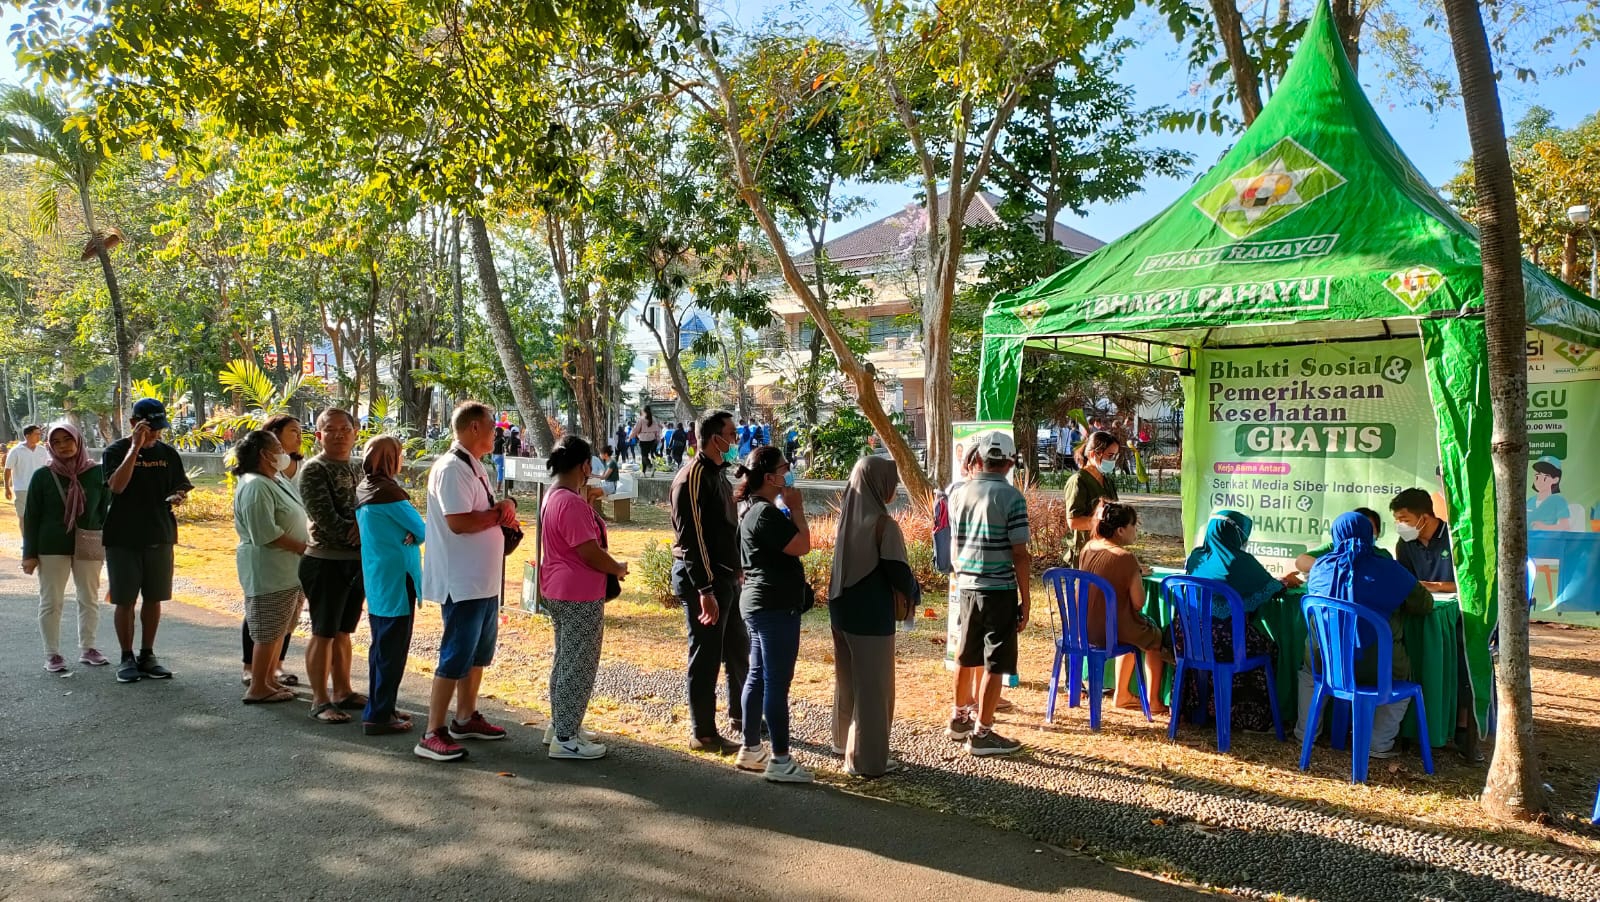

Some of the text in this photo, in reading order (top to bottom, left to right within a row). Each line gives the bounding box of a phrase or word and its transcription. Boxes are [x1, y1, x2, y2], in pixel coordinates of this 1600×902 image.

[1146, 238, 1328, 270] BHAKTI RAHAYU
[1094, 278, 1320, 315] BHAKTI RAHAYU
[1526, 340, 1544, 356] SI
[1210, 359, 1289, 379] Bhakti
[1301, 356, 1382, 377] Sosial
[1209, 380, 1385, 401] Pemeriksaan
[1208, 403, 1347, 422] Kesehatan
[1247, 426, 1382, 453] GRATIS
[1259, 464, 1286, 472] Antara
[1252, 479, 1289, 490] Media
[1293, 480, 1328, 491] Siber
[1333, 481, 1402, 495] Indonesia
[1210, 493, 1255, 511] (SMSI)
[1260, 495, 1292, 509] Bali
[1252, 515, 1303, 534] HAKTI
[1246, 543, 1293, 557] riksaan:
